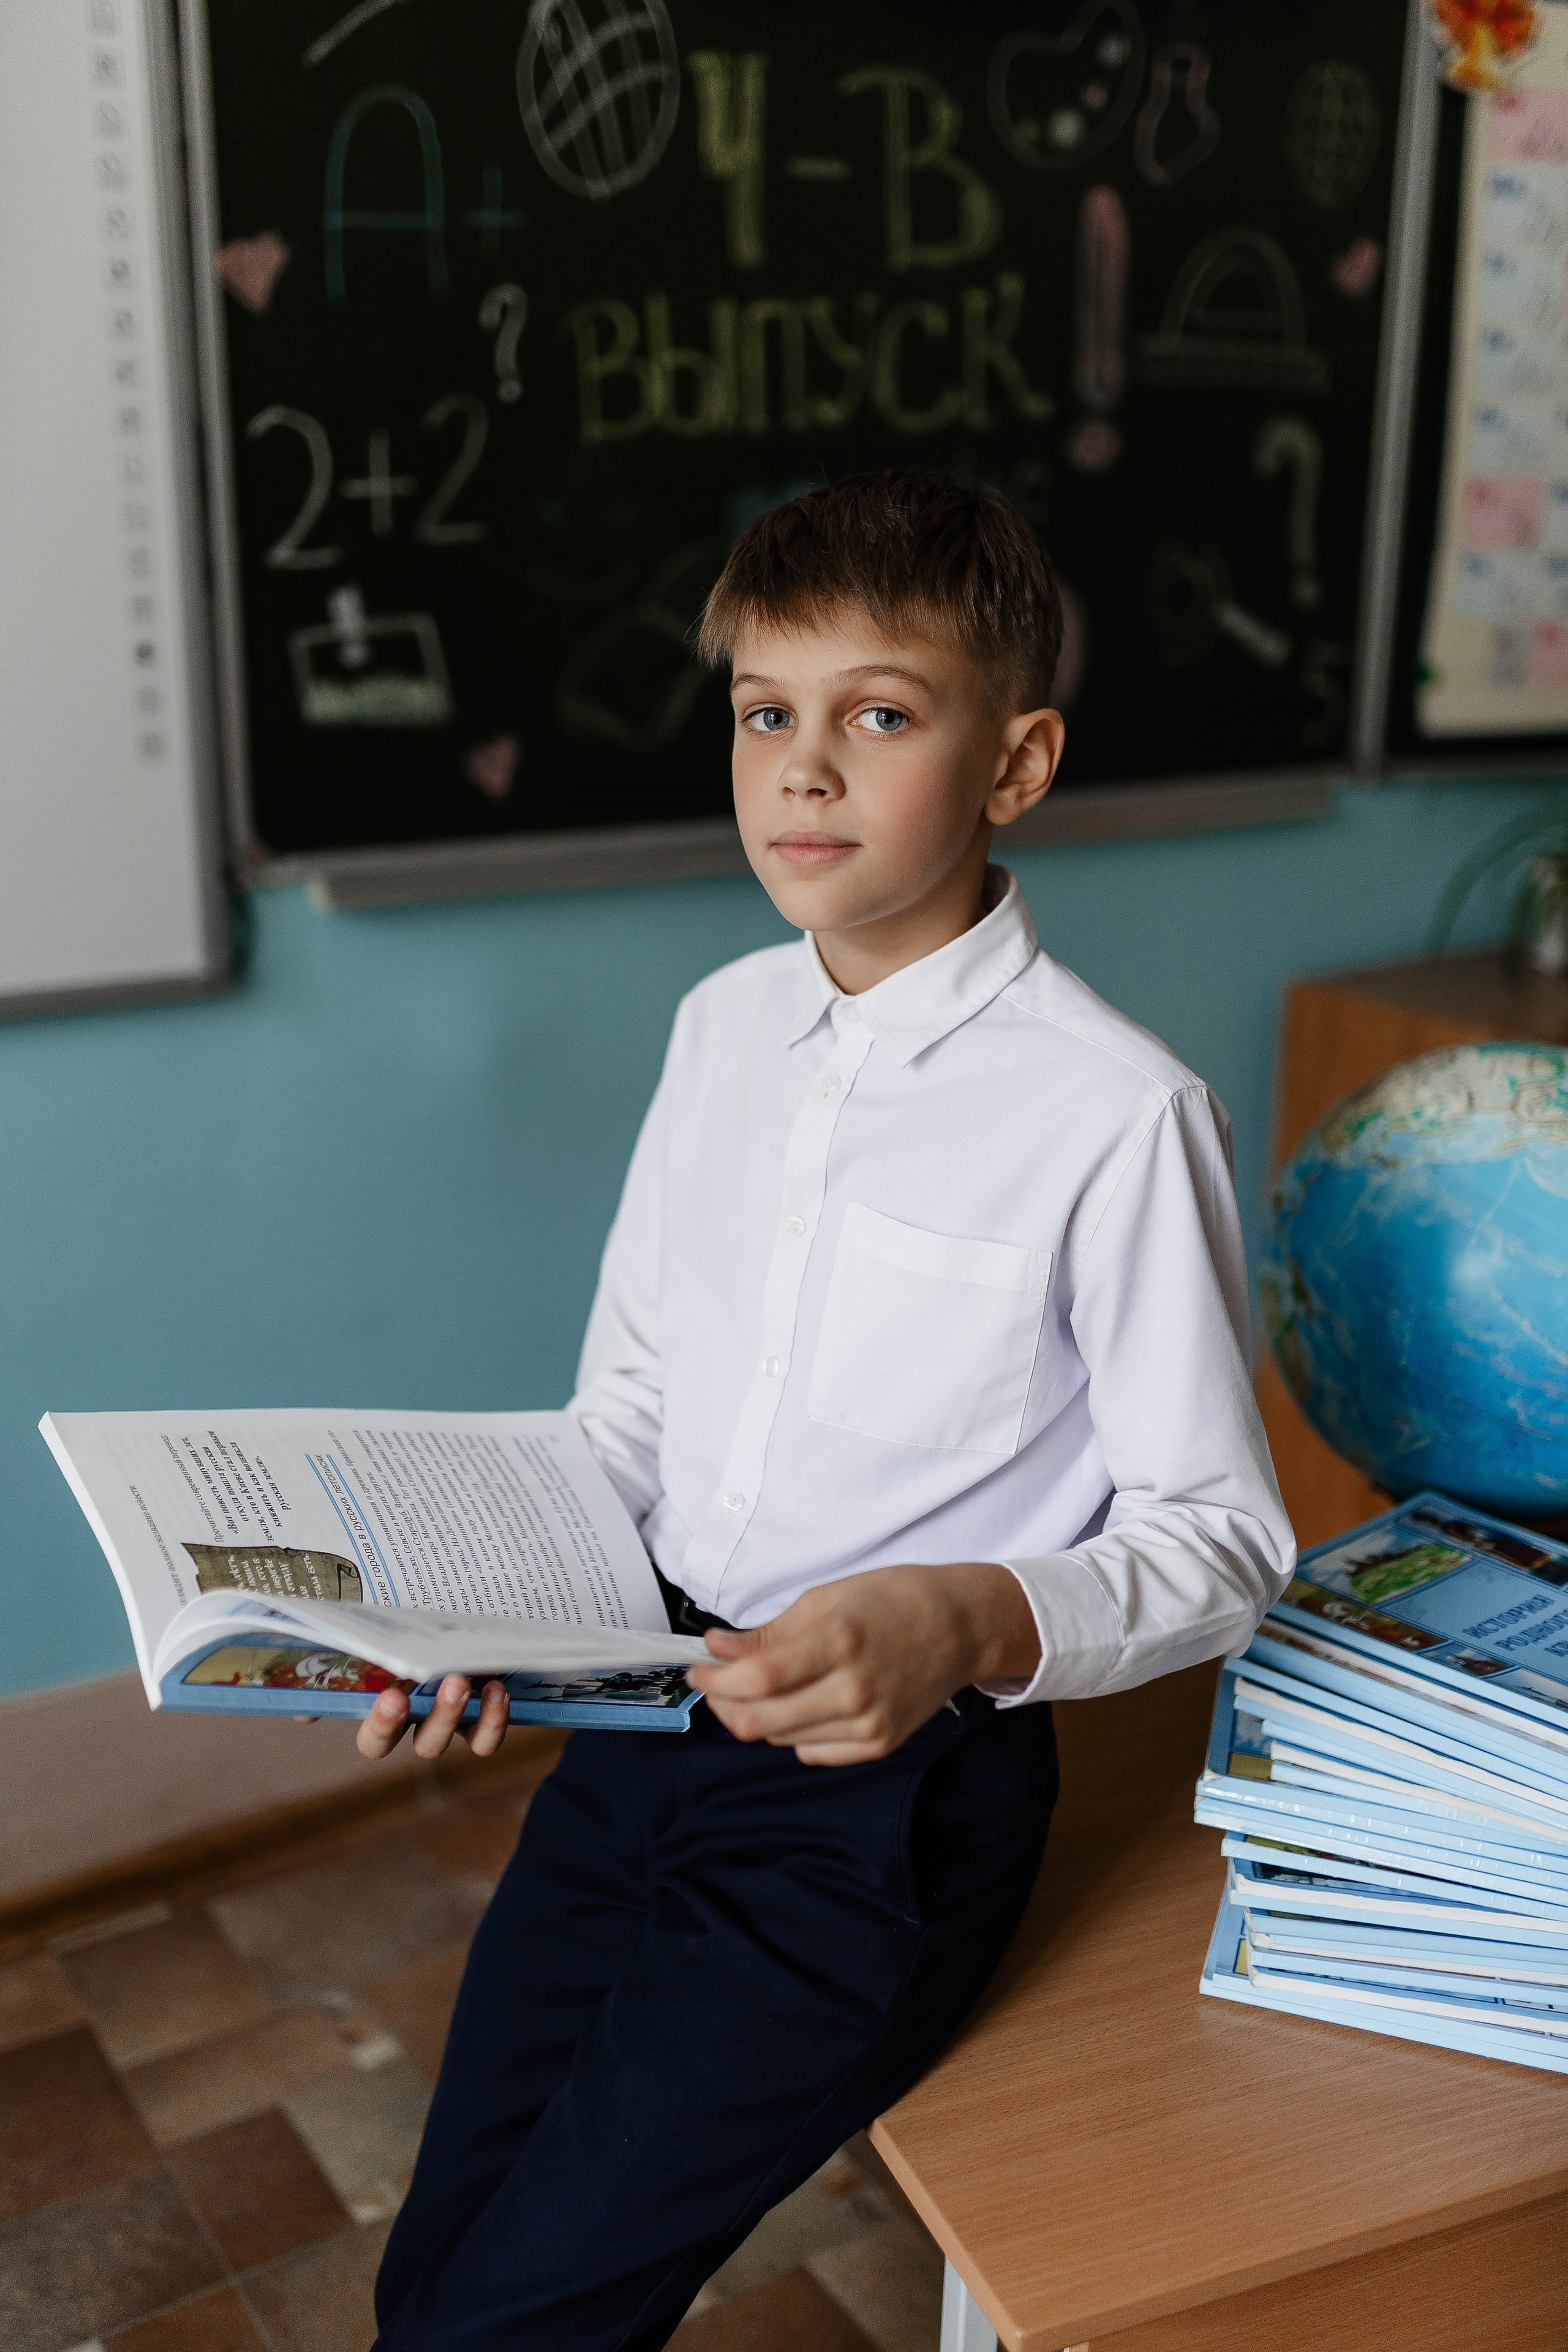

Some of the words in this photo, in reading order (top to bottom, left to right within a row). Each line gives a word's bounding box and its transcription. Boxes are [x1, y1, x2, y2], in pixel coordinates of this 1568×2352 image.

[246, 392, 490, 570] 2+2
[189, 1450, 214, 1483] минувших
[202, 1447, 225, 1471] русская
[224, 1457, 237, 1471] стал
[230, 1442, 252, 1471] возникла
[372, 1461, 383, 1472] нем
[173, 1460, 203, 1500] современный
[218, 1473, 235, 1494] пошла
[233, 1473, 250, 1493] Киеве
[249, 1474, 260, 1485] как
[315, 1455, 344, 1494] летописях
[350, 1468, 372, 1494] древних
[367, 1472, 384, 1494] других.
[129, 1485, 147, 1510] повести:
[211, 1486, 230, 1513] повесть
[269, 1483, 292, 1510] русская
[384, 1480, 404, 1508] Впервые
[401, 1489, 411, 1500] Тот
[232, 1498, 249, 1521] откуда
[249, 1502, 261, 1514] кто
[261, 1494, 282, 1526] княжить
[339, 1497, 364, 1531] русских
[379, 1496, 397, 1520] многих
[409, 1502, 431, 1539] Мономаха.
[418, 1498, 436, 1522] напали
[433, 1501, 444, 1514] они
[469, 1500, 494, 1541] Мономахом
[143, 1512, 163, 1543] название
[199, 1502, 224, 1542] Прочитайте
[225, 1516, 239, 1534] «Вот
[258, 1517, 274, 1542] земля,
[369, 1502, 398, 1546] упоминания
[399, 1510, 424, 1546] Стародуб.
[440, 1515, 457, 1537] Десне
[467, 1519, 480, 1534] году
[510, 1507, 529, 1539] Мономах
[396, 1529, 412, 1553] Севске
[432, 1525, 452, 1557] половцы
[451, 1538, 460, 1547] На
[477, 1539, 491, 1561] каком
[497, 1531, 519, 1571] летописец
[505, 1521, 529, 1566] стародубцы
[159, 1544, 175, 1572] полное
[363, 1544, 382, 1577] города
[428, 1542, 450, 1586] Владимира
[458, 1548, 470, 1572] город.
[491, 1544, 507, 1569] между
[538, 1541, 553, 1568] храбро
[393, 1548, 417, 1600] встречаются
[410, 1556, 432, 1605] Трубчевске,
[418, 1548, 445, 1602] упоминается
[447, 1560, 462, 1586] зимой
[503, 1573, 516, 1598] войне
[516, 1574, 527, 1589] раз,
[480, 1577, 494, 1608] отбили
[492, 1574, 508, 1605] указал,
[542, 1582, 550, 1591] не
[564, 1578, 576, 1602] голод
[533, 1587, 548, 1621] узнаем,
[546, 1595, 558, 1620] город
